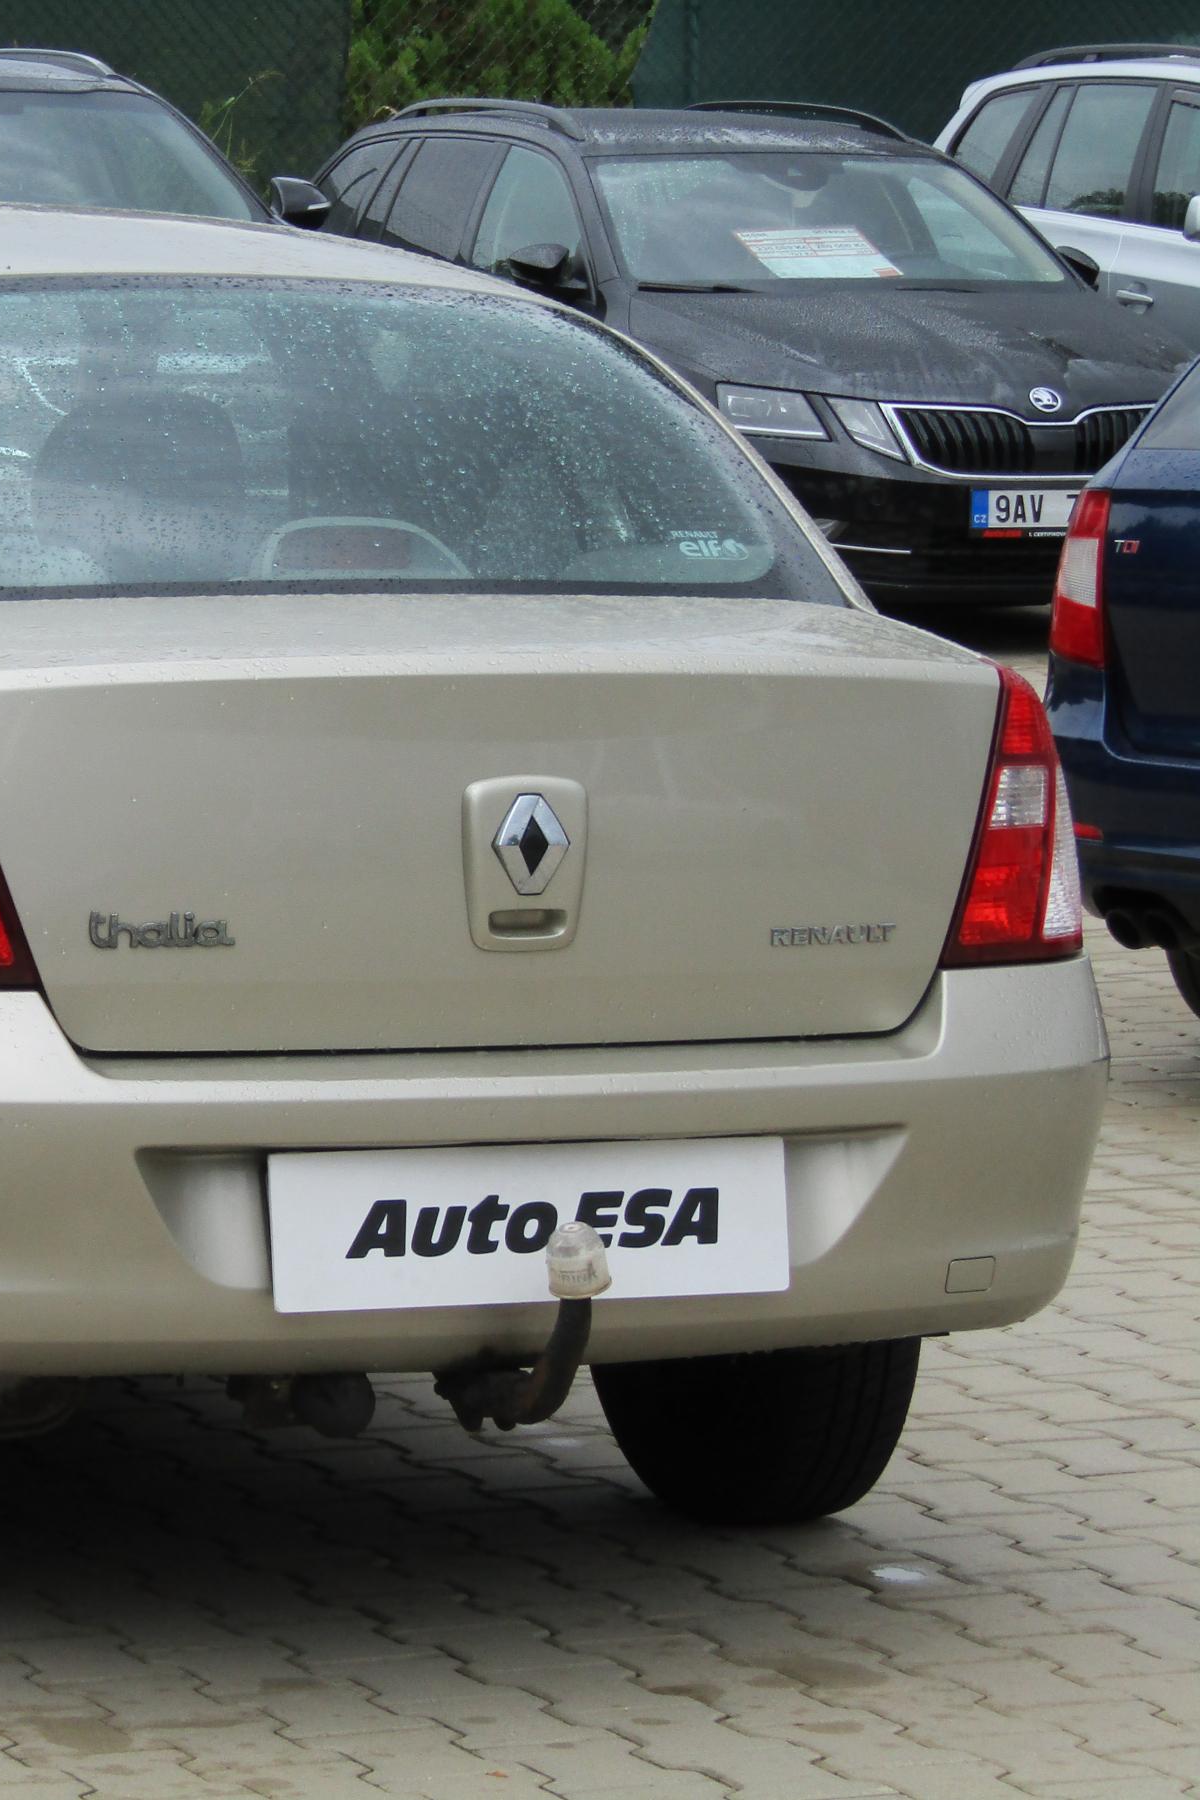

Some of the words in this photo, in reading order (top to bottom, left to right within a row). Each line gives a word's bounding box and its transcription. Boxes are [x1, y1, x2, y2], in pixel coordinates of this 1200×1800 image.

[995, 494, 1044, 524] 9AV
[973, 514, 987, 524] CZ
[670, 530, 718, 539] RENAULT
[679, 540, 722, 557] elf
[1114, 539, 1141, 554] TDI
[769, 922, 897, 947] RENAULT
